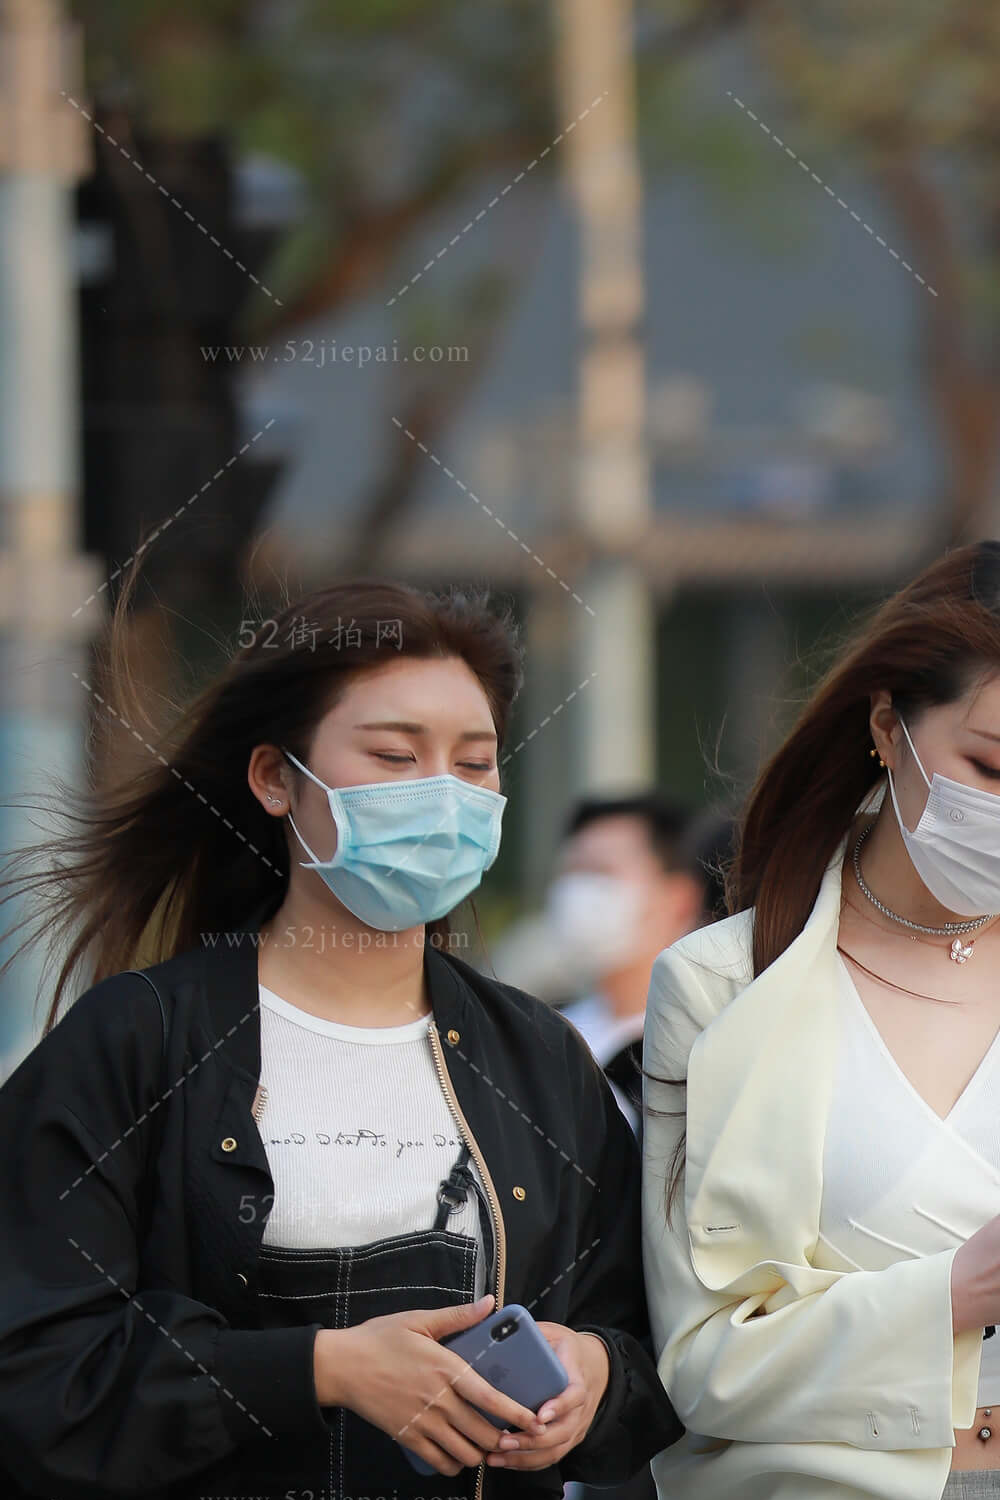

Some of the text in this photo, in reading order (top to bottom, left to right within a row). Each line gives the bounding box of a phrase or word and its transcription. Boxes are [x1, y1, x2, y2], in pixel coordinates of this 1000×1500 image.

[264, 1133, 306, 1145] now
[316, 1131, 361, 1147] what
[397, 1138, 424, 1158] you
